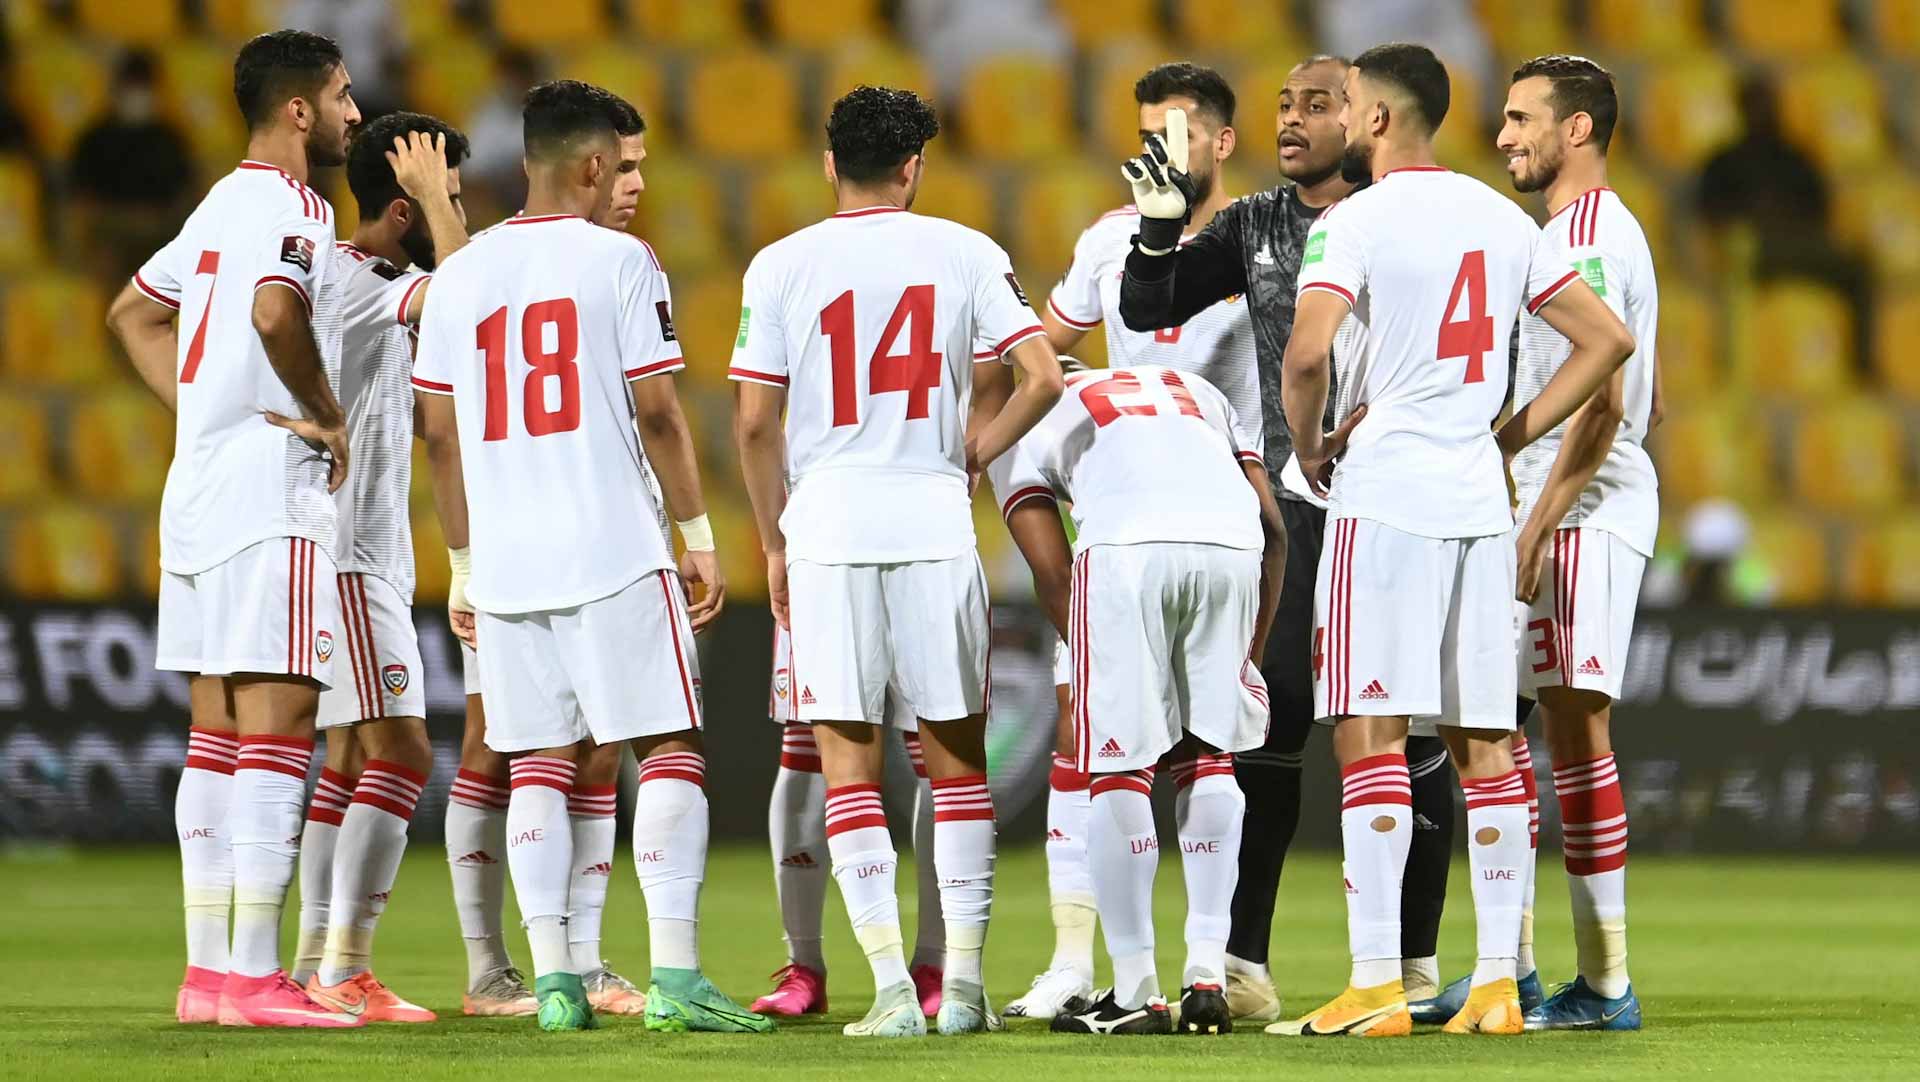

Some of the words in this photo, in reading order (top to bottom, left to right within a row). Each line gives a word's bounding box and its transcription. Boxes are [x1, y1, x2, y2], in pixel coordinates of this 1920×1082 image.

[179, 250, 220, 384] 7
[1436, 249, 1495, 385] 4
[820, 283, 943, 428] 14
[475, 297, 581, 442] 18
[1527, 617, 1557, 674] 3
[1577, 668, 1604, 676] adidas
[1358, 692, 1389, 700] adidas
[1097, 749, 1126, 758] adidas
[182, 827, 217, 841] UAE
[511, 828, 544, 848] UAE
[1182, 840, 1220, 854] UAE
[857, 863, 890, 879] UAE
[1484, 868, 1516, 881] UAE
